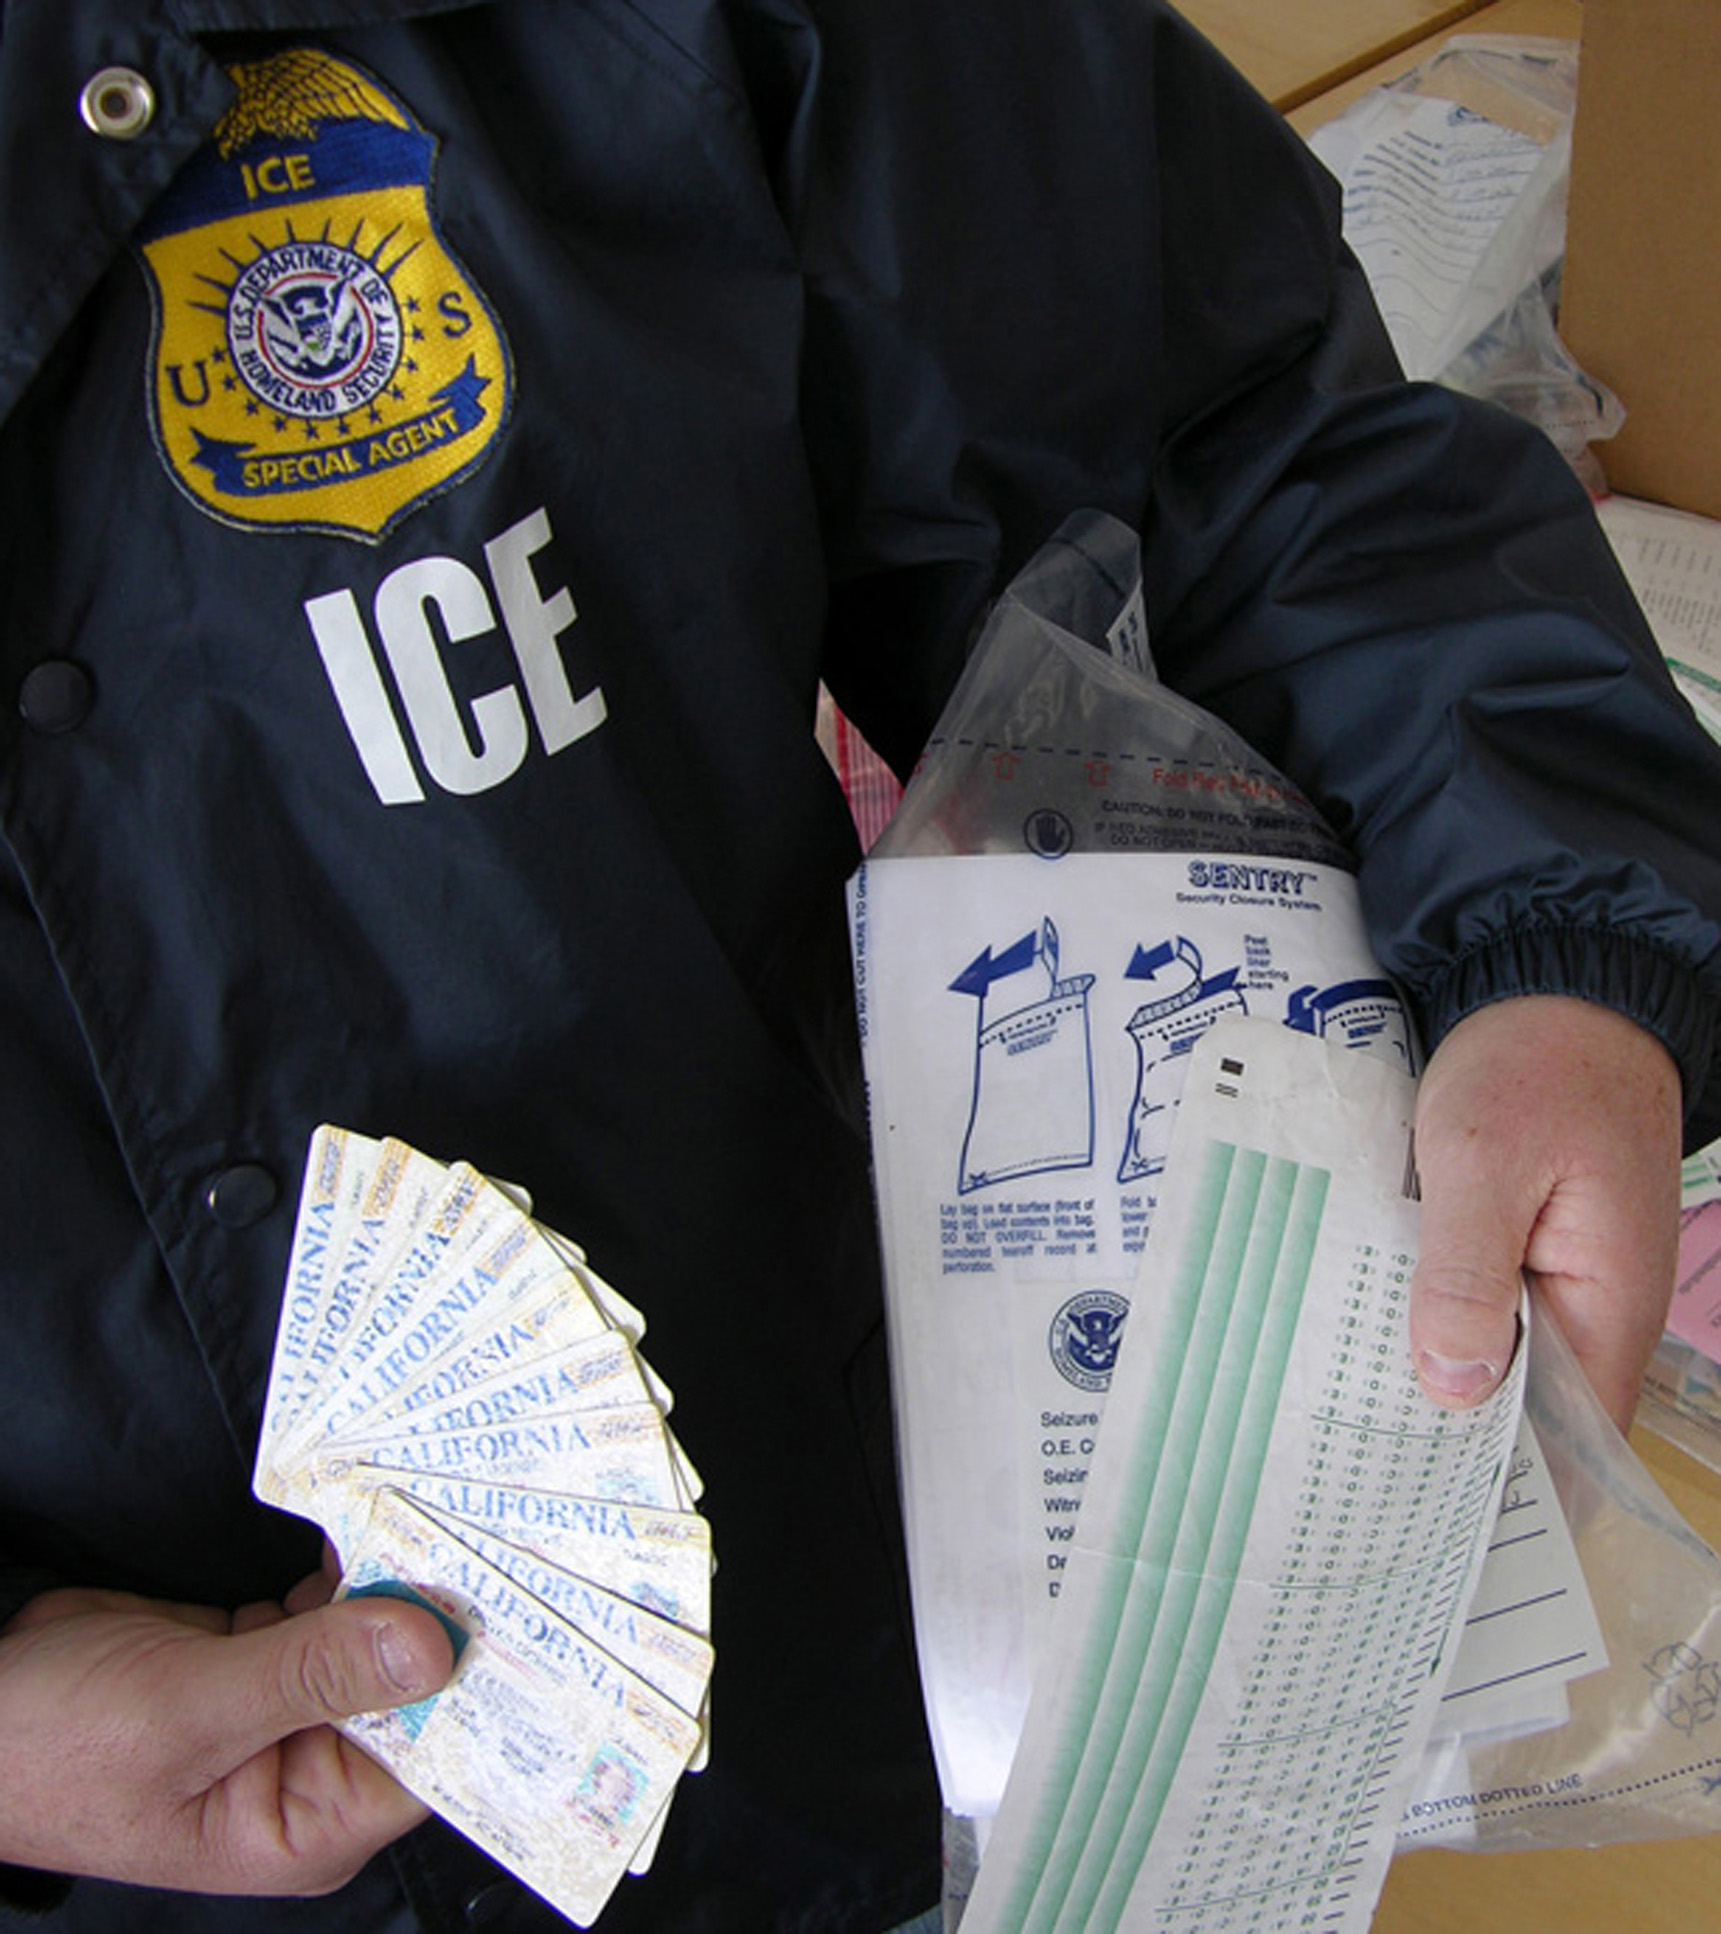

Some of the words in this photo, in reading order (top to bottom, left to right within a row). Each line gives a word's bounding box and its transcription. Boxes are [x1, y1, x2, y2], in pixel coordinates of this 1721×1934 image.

[241, 155, 314, 198] ICE
[240, 248, 365, 303] DEPARTMENT
[166, 360, 211, 407] U
[437, 291, 473, 338] S
[240, 350, 337, 412] HOMELAND
[341, 312, 395, 404] SECURITY
[243, 442, 361, 488] SPECIAL
[368, 407, 461, 468] AGENT
[303, 506, 608, 806] ICE
[1176, 892, 1226, 906] Security
[1229, 893, 1276, 907] Closure
[1279, 898, 1323, 911] System
[1188, 861, 1307, 895] SENTRY
[1041, 1411, 1098, 1428] Seizure
[372, 1421, 591, 1471] CALIFORNIA
[429, 1541, 625, 1708] CALIFORNIA
[1411, 1795, 1477, 1819] BOTTOM
[1479, 1784, 1543, 1806] DOTTED
[1546, 1772, 1583, 1795] LINE
